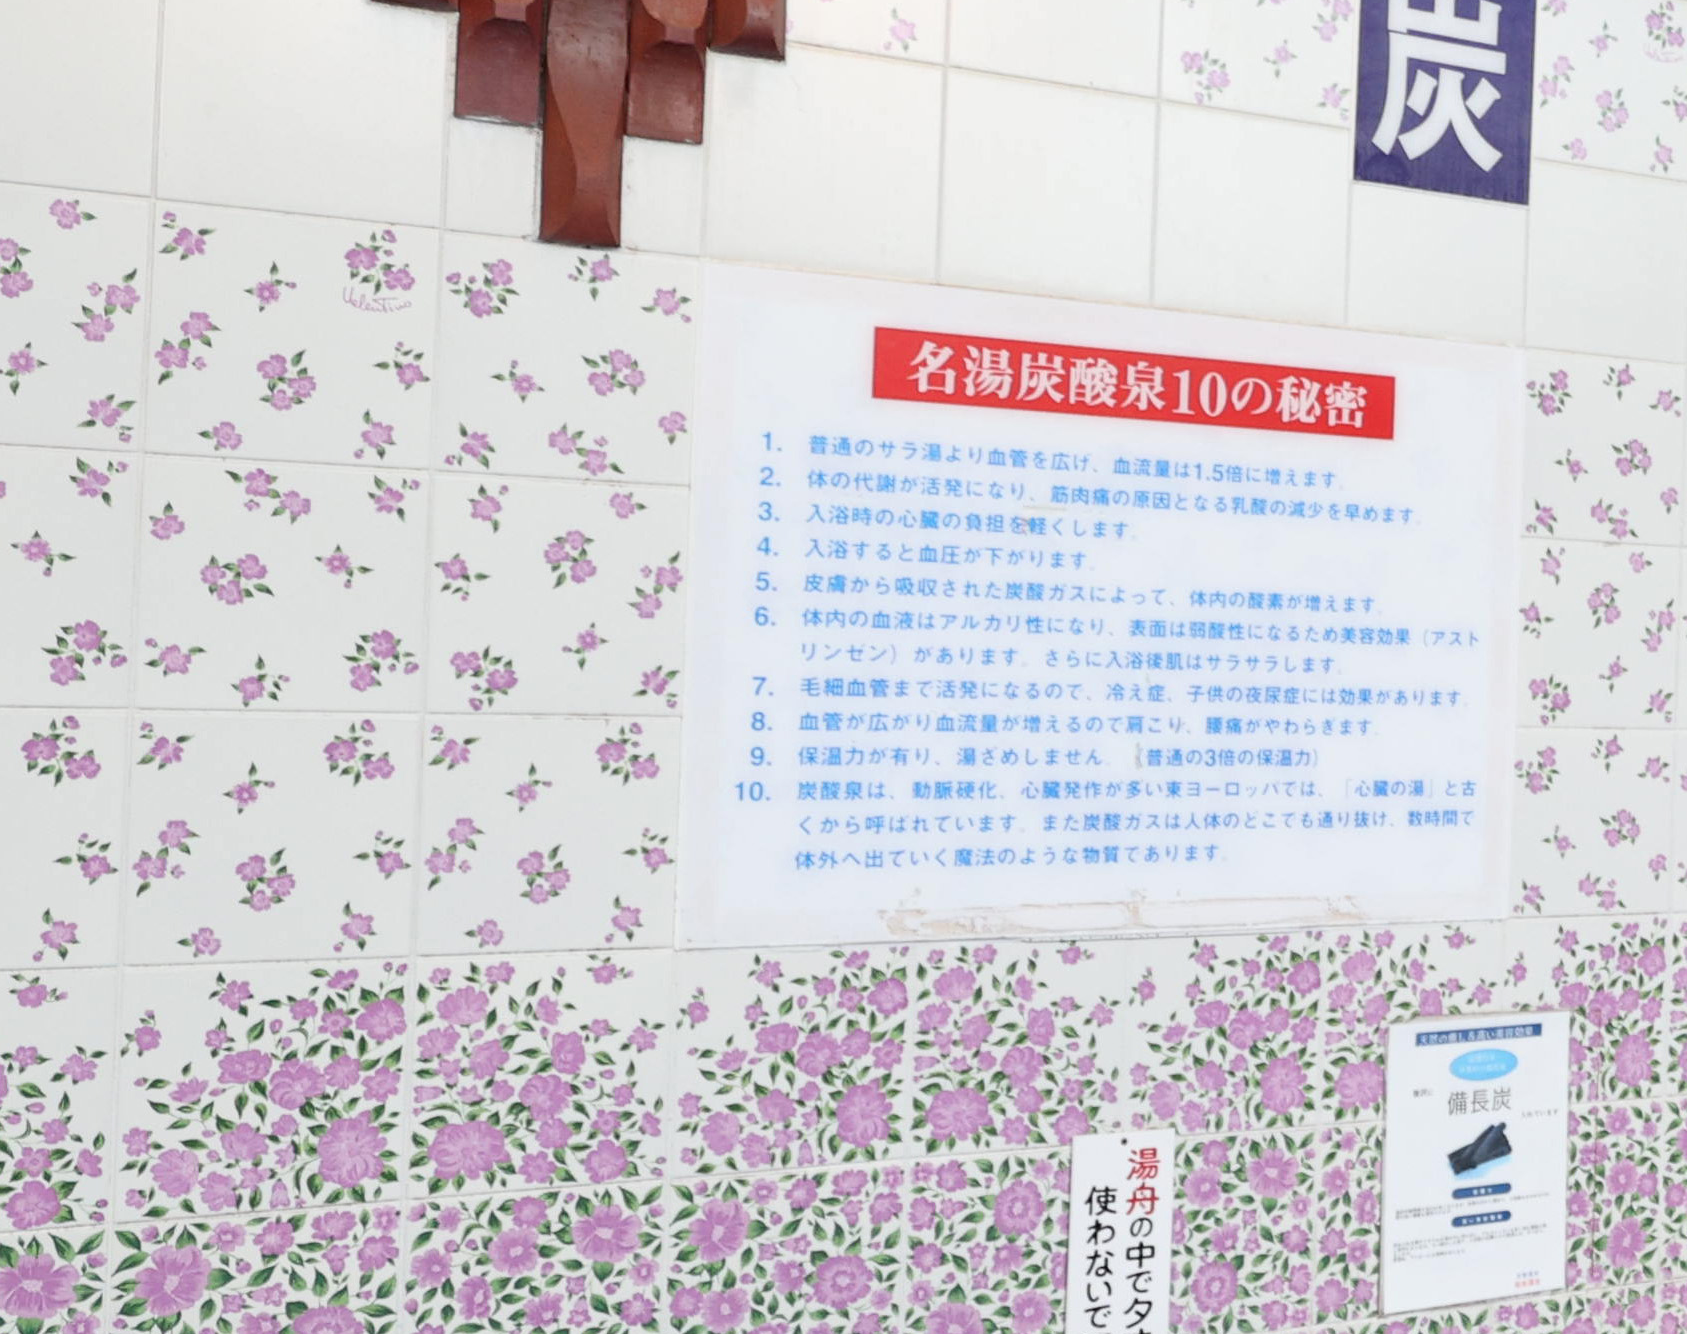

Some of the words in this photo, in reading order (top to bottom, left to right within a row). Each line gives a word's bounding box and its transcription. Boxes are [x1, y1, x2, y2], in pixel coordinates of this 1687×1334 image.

[907, 338, 1370, 431] 名湯炭酸泉10の秘密
[1447, 1086, 1512, 1116] 備長炭
